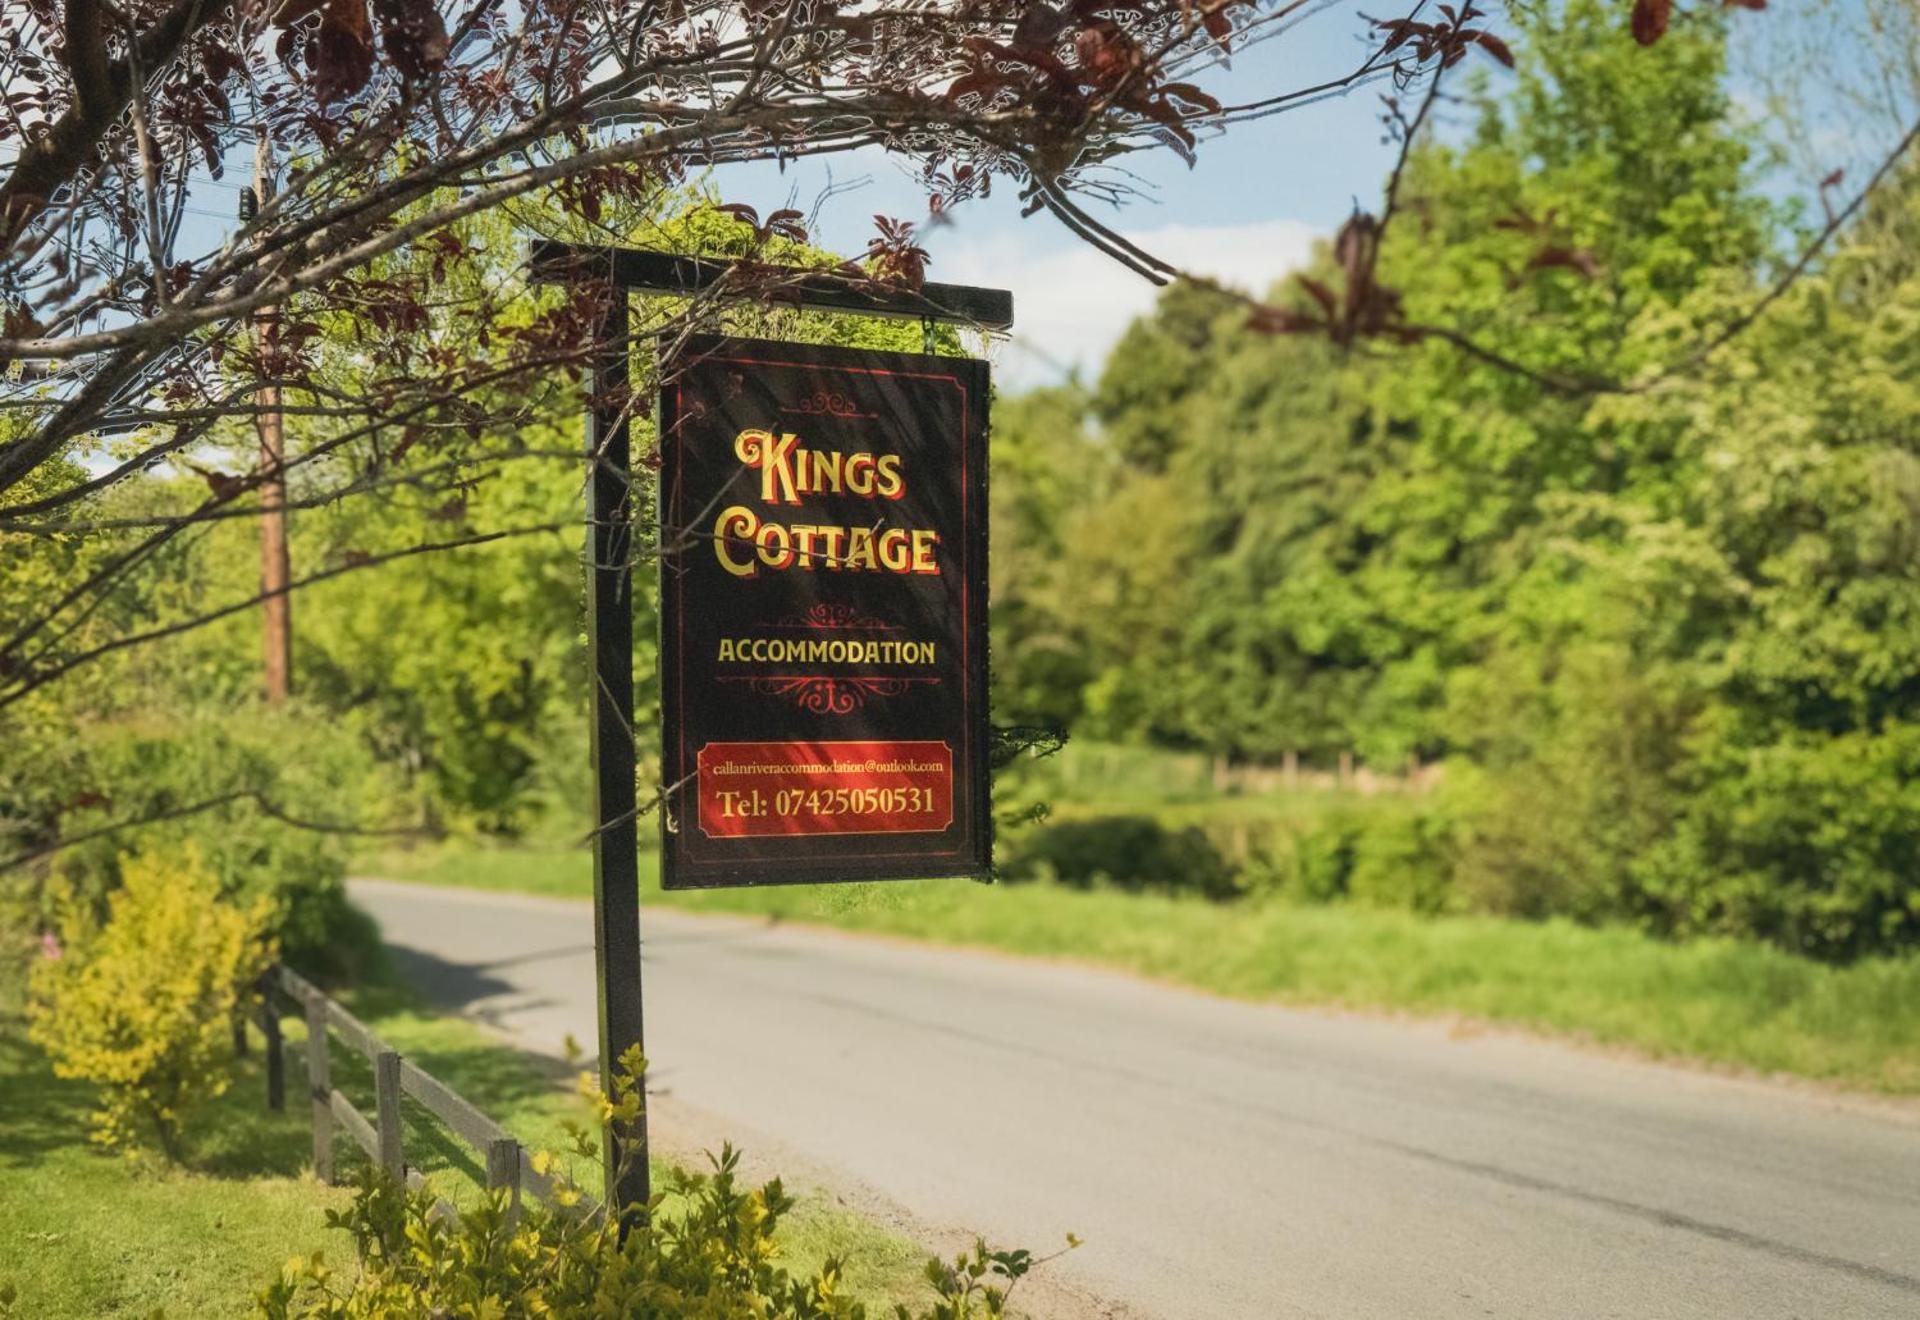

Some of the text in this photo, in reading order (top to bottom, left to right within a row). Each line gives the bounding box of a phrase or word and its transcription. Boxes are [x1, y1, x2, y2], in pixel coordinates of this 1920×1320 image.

[734, 428, 906, 504] KINGS
[713, 505, 940, 577] COTTAGE
[717, 638, 935, 664] ACCOMMODATION
[713, 760, 943, 775] callanriveraccommodation@outlook.com
[716, 787, 935, 817] Tel: 07425050531
